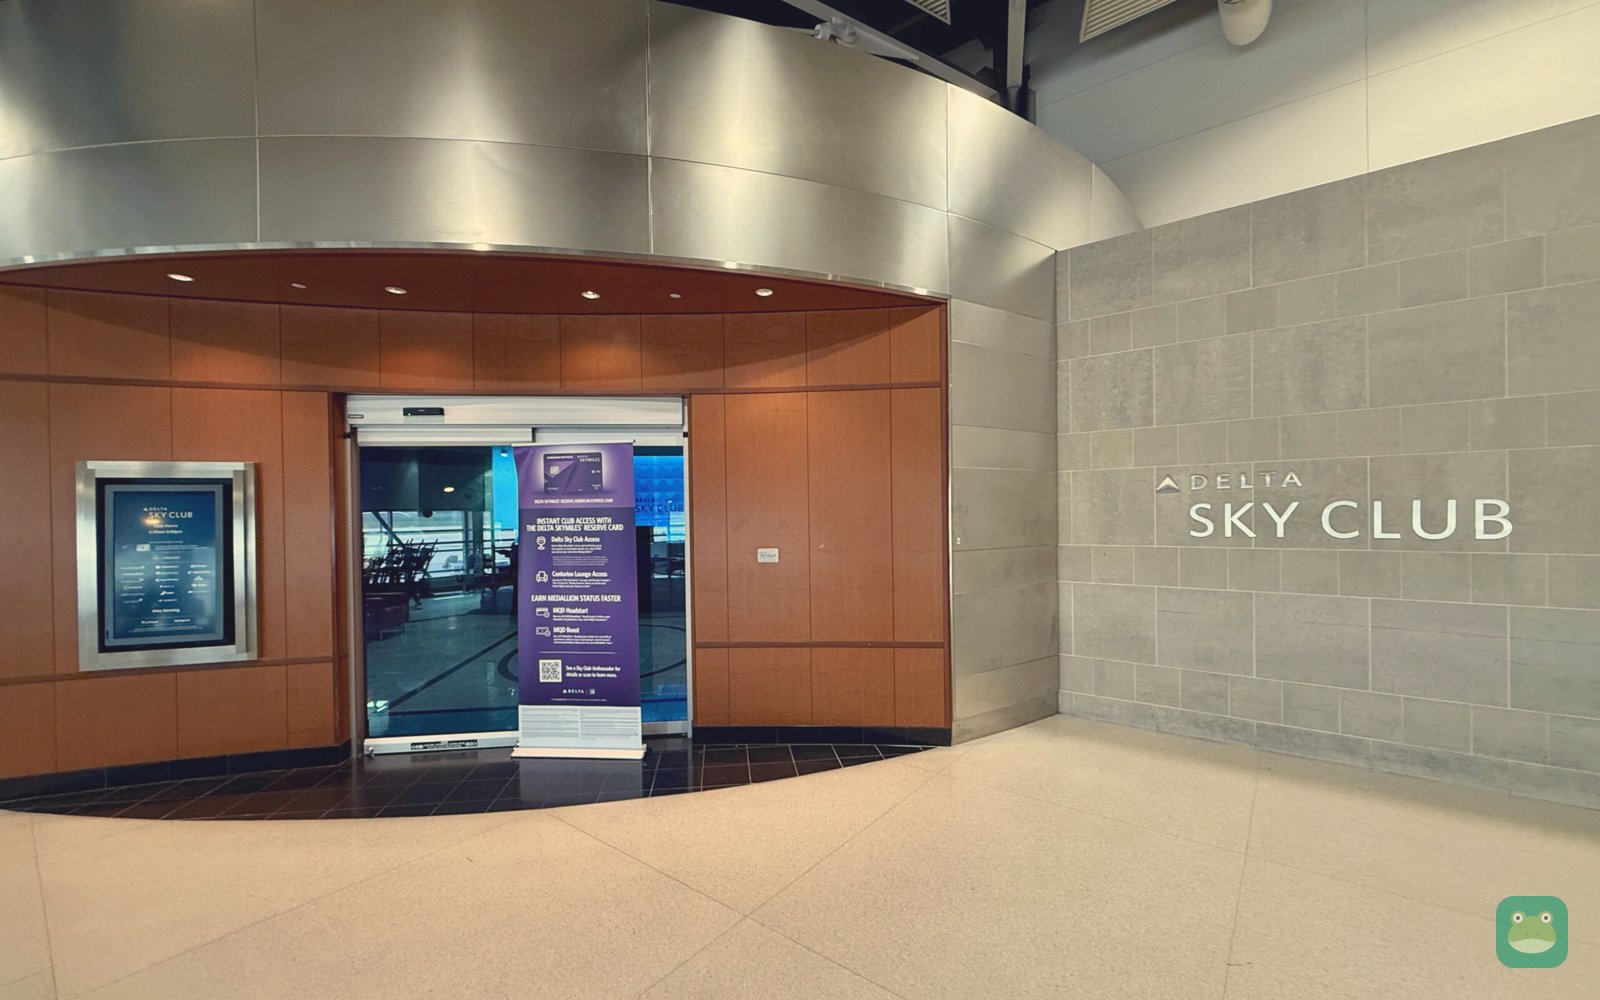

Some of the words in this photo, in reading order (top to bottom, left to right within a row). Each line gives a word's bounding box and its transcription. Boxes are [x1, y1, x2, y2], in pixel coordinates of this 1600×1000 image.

[1190, 471, 1303, 490] DELTA
[657, 504, 684, 513] CLUB
[168, 511, 193, 519] CLUB
[1189, 501, 1300, 538] SKY
[1321, 498, 1514, 540] CLUB
[564, 536, 573, 544] Sky
